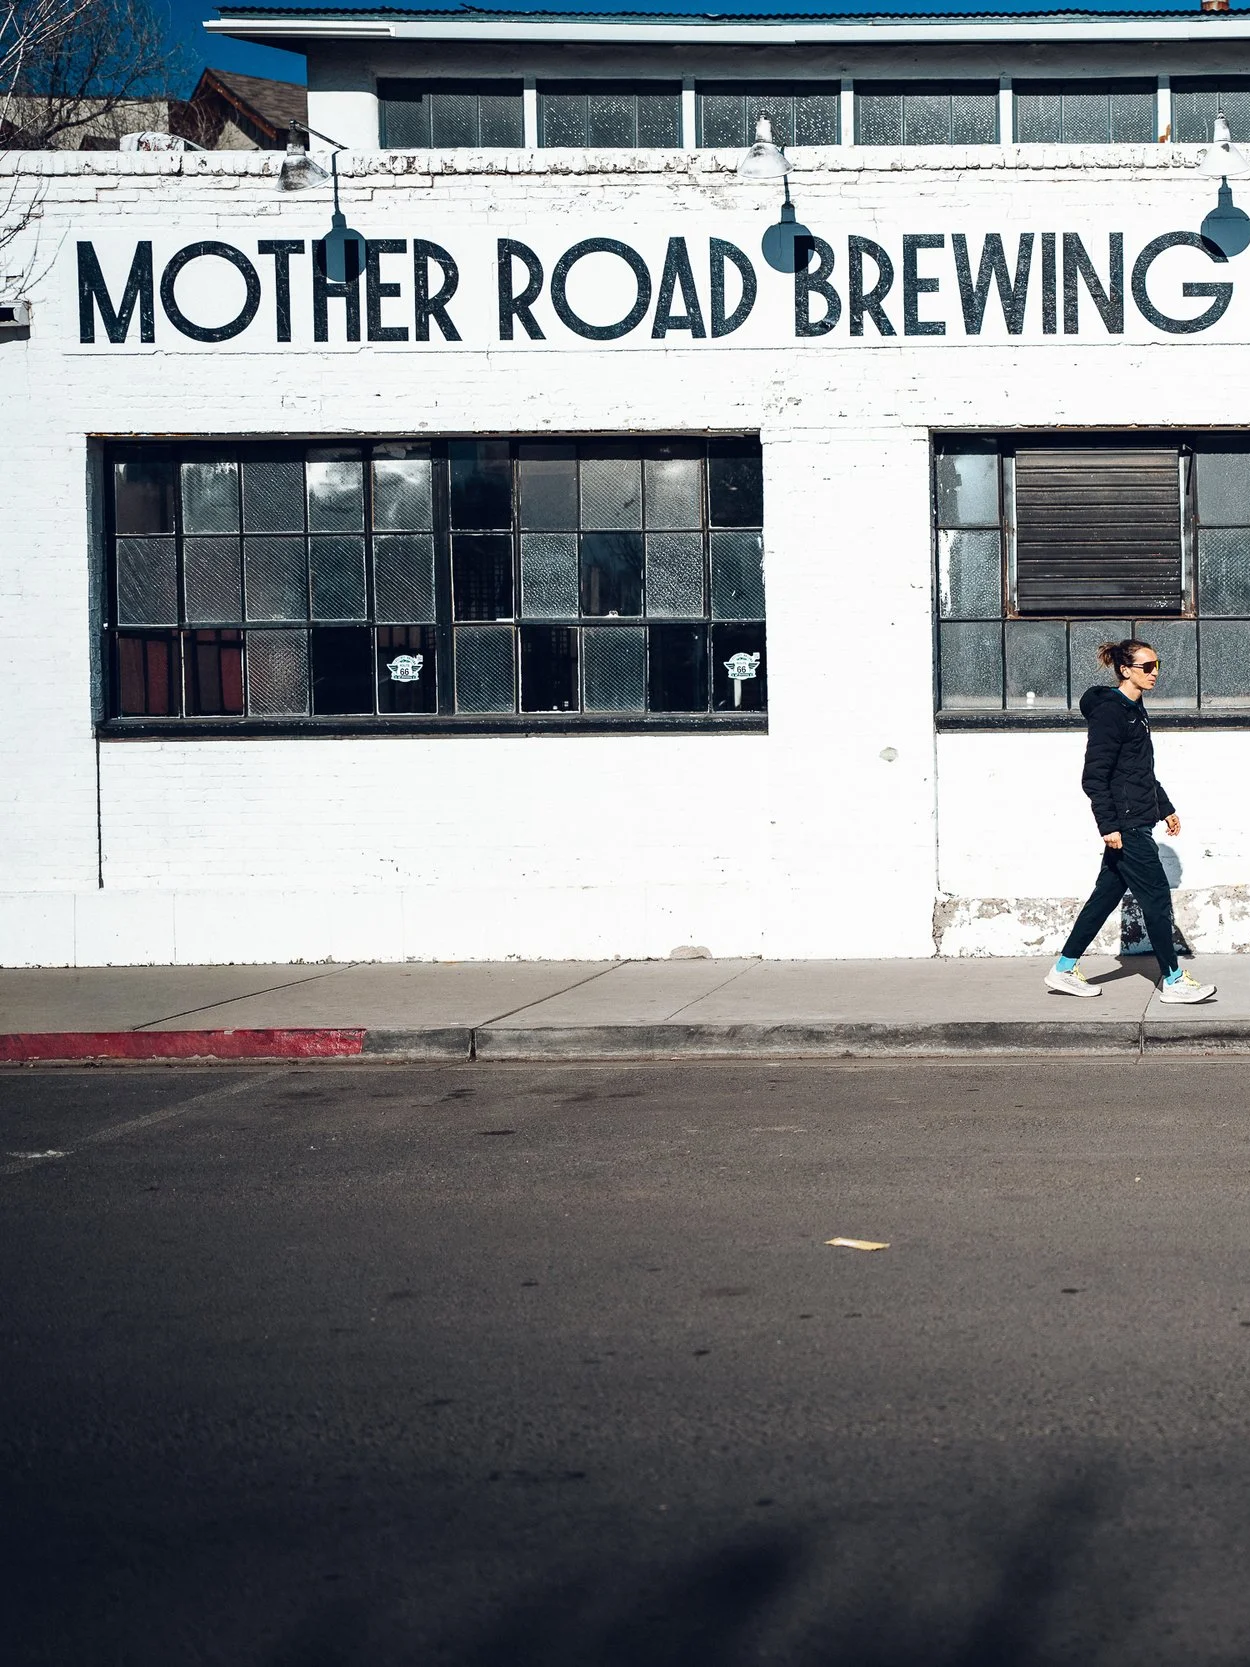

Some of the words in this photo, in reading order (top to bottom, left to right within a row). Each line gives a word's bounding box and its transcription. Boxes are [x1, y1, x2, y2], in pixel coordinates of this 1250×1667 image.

[77, 238, 464, 344] MOTHER
[498, 235, 758, 341] ROAD
[793, 230, 1235, 338] BREWING
[400, 668, 410, 676] 66
[736, 665, 746, 673] 66
